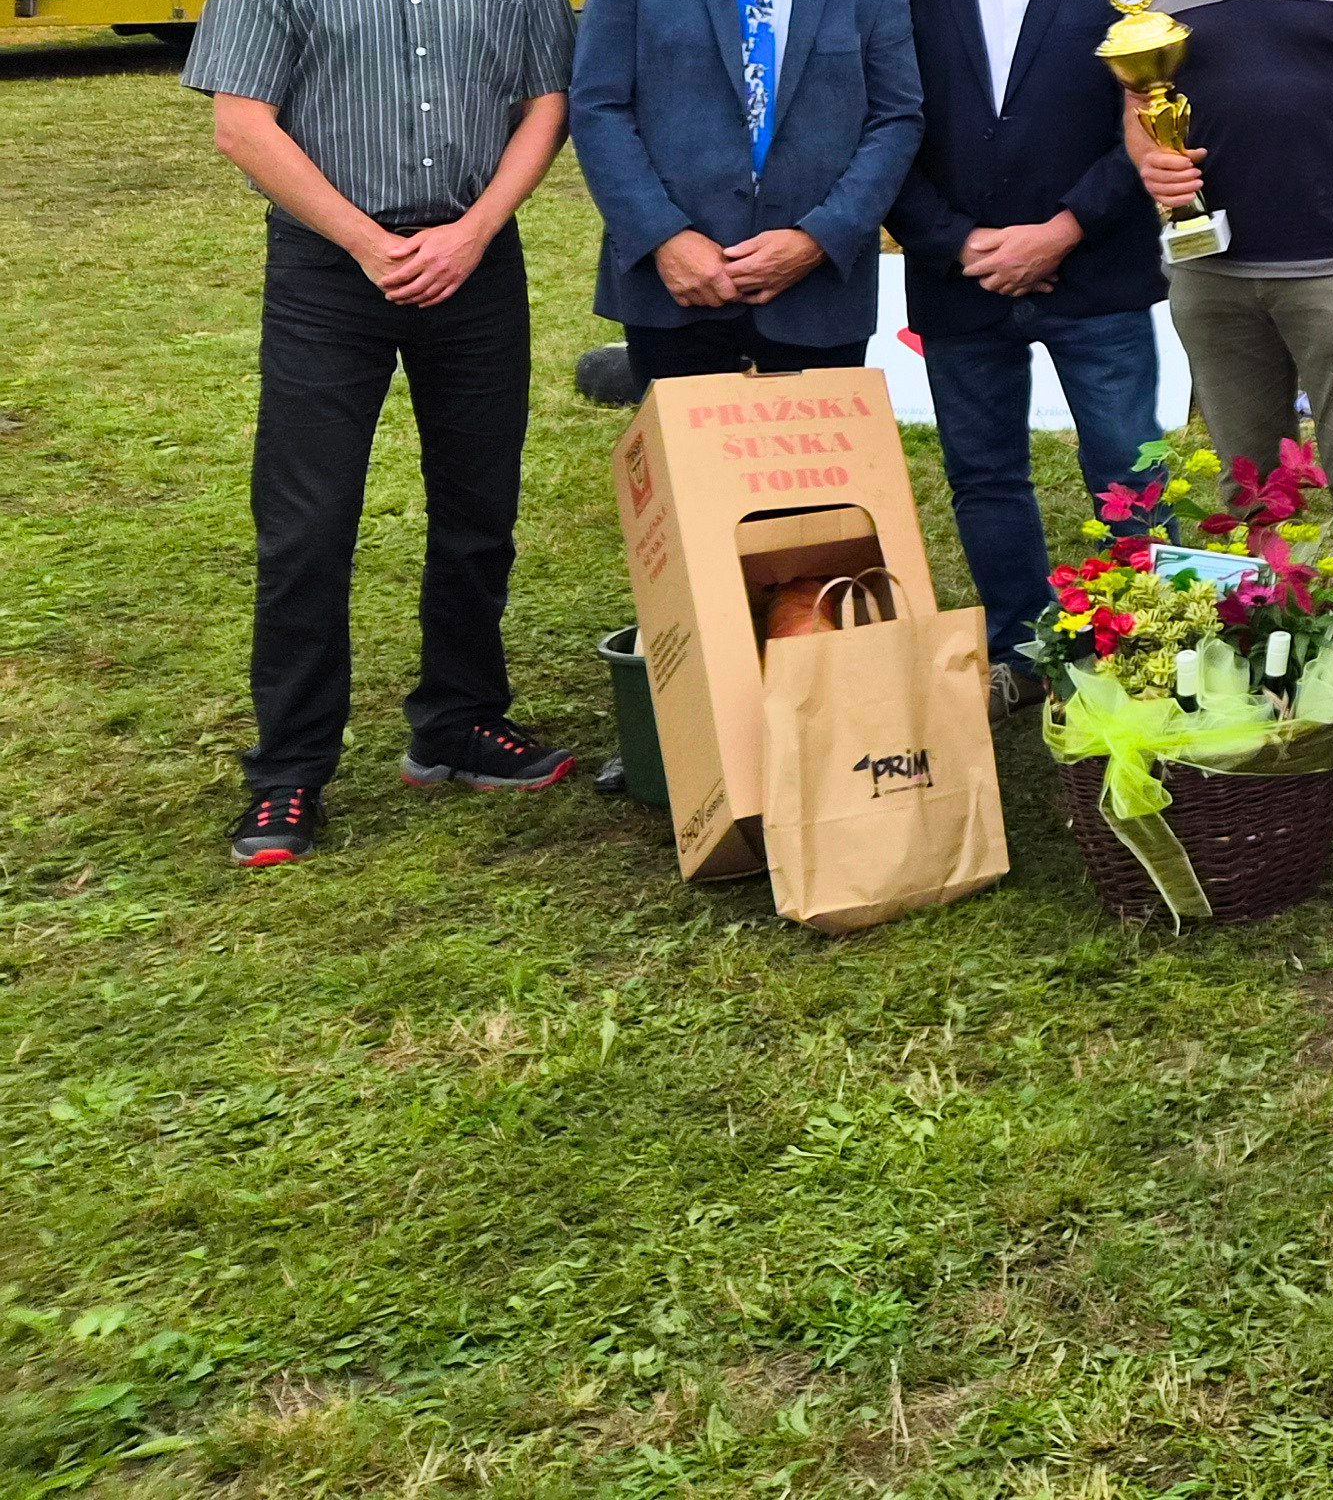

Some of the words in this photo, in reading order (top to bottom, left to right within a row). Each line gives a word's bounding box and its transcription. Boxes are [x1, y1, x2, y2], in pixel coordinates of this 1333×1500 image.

[687, 391, 872, 429] PRAŽSKÁ
[721, 431, 854, 460] ŠUNKA
[740, 466, 849, 494] TORO
